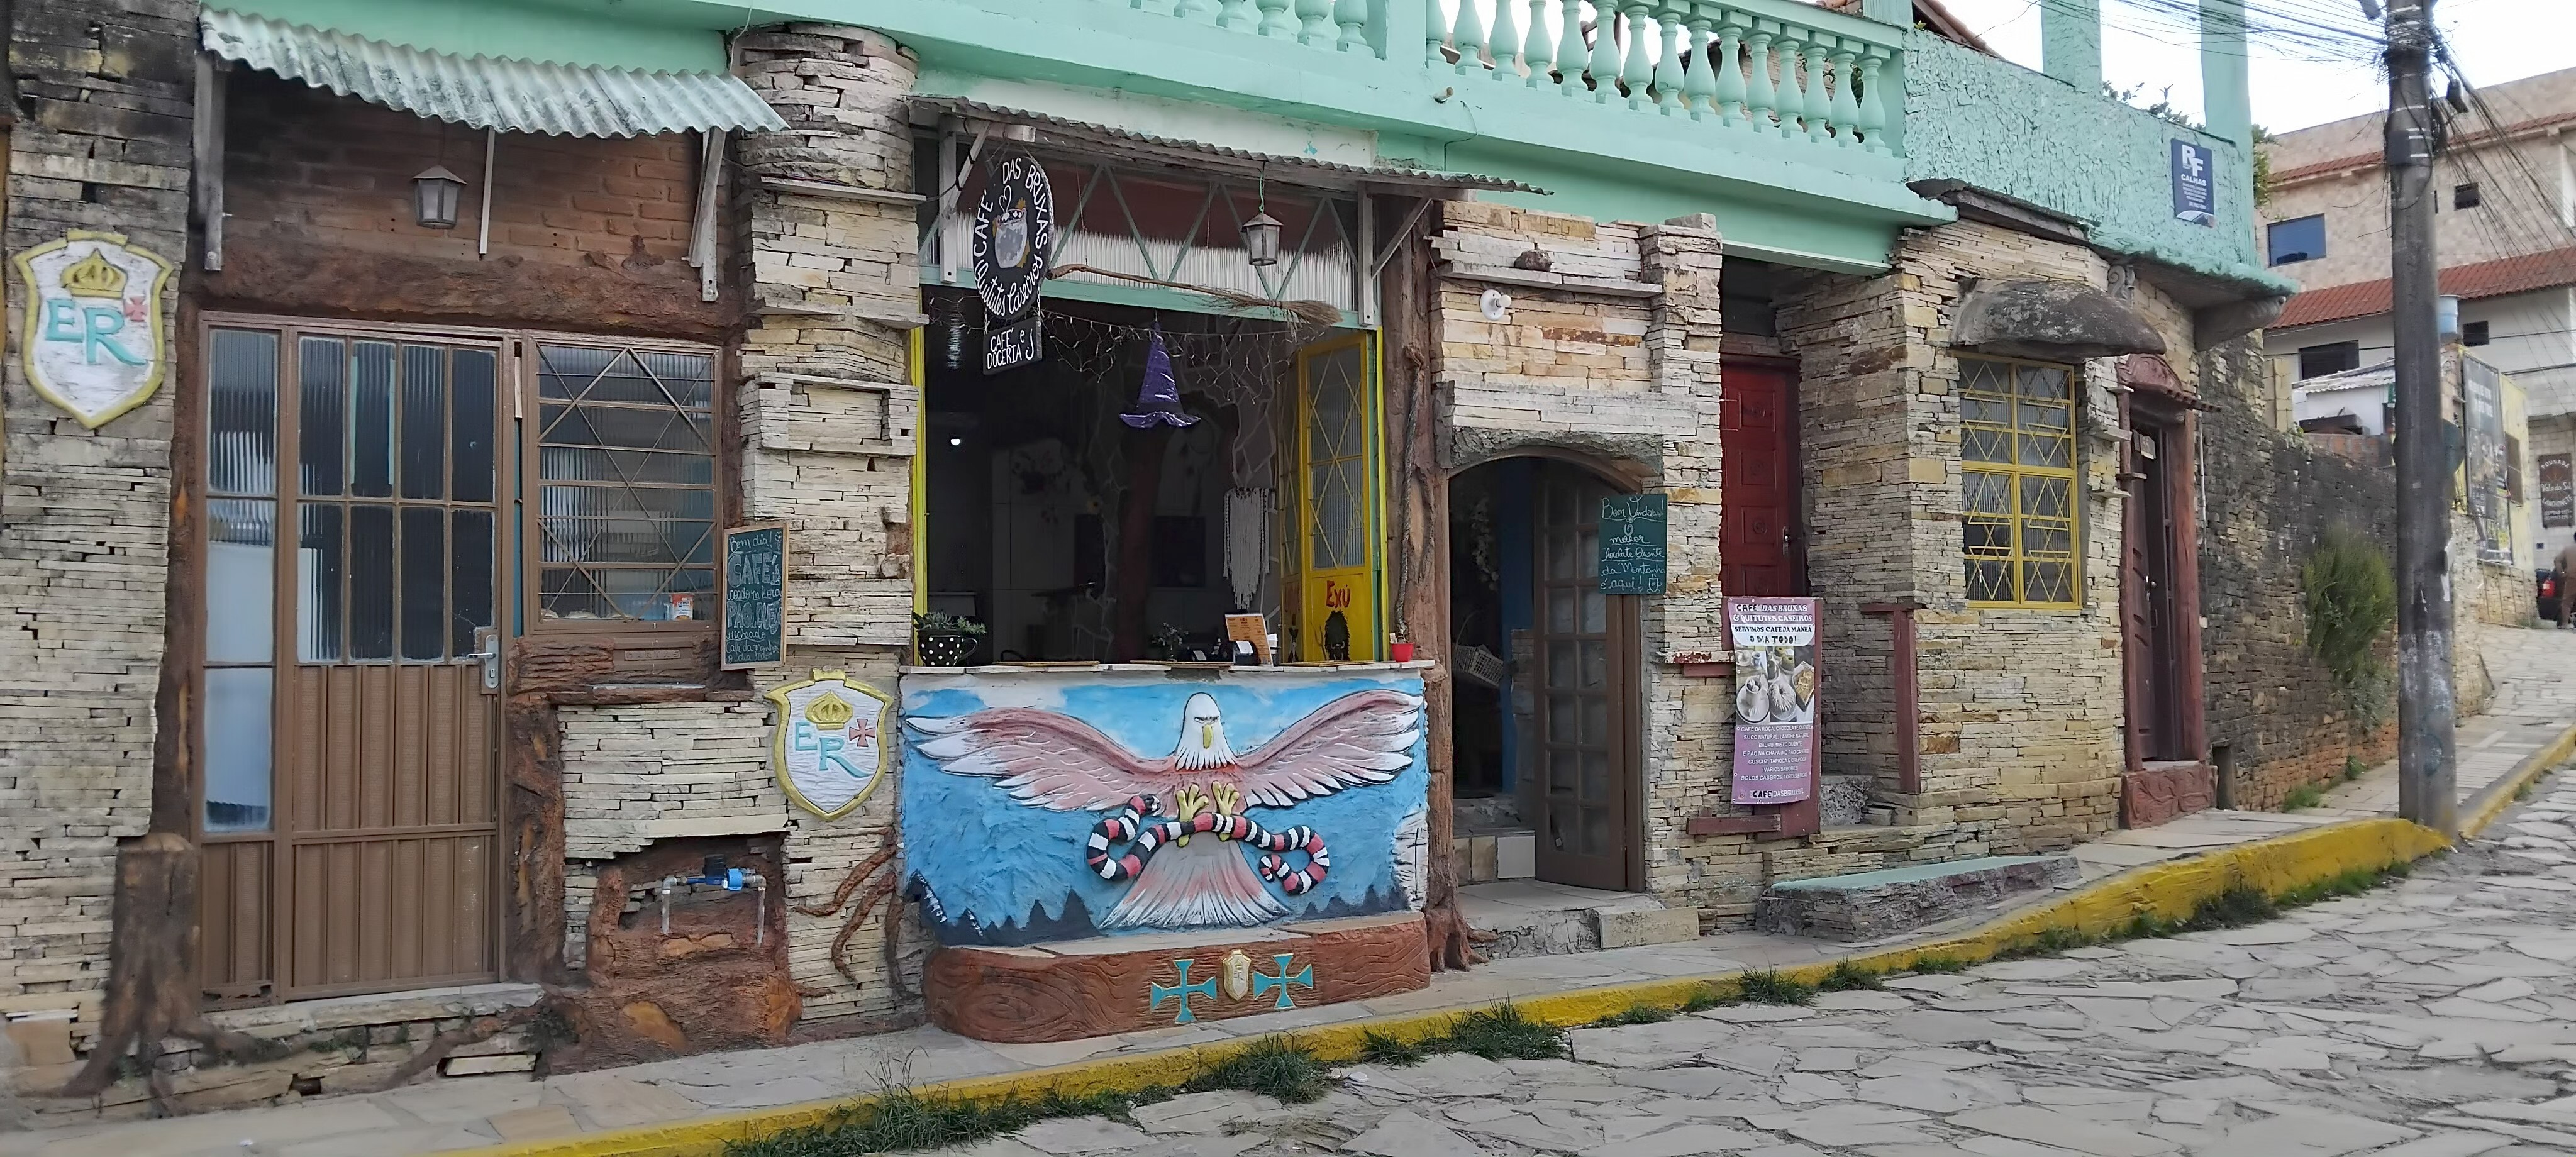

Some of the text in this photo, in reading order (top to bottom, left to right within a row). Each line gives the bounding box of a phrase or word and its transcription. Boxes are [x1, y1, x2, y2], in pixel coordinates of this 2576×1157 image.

[2182, 144, 2204, 177] RF
[1002, 157, 1021, 185] DAS
[1025, 165, 1048, 250] BRUXAS
[1007, 254, 1043, 314] Caseiros
[45, 298, 148, 366] ER
[1019, 330, 1026, 343] e
[987, 344, 1023, 370] DOCERIA
[2541, 459, 2570, 469] POUSADA
[1601, 497, 1626, 519] Bem
[1609, 534, 1650, 545] melhor
[1635, 547, 1665, 558] Quente
[1601, 562, 1666, 577] da Montanha
[1600, 578, 1608, 590] é
[1326, 580, 1351, 609] Exú
[1761, 604, 1777, 612] DAS
[1778, 604, 1808, 612] BRUXAS
[726, 628, 766, 640] recheado
[1765, 624, 1782, 633] CAFÉ
[1791, 624, 1812, 633] MANHÃ
[794, 721, 874, 778] ER
